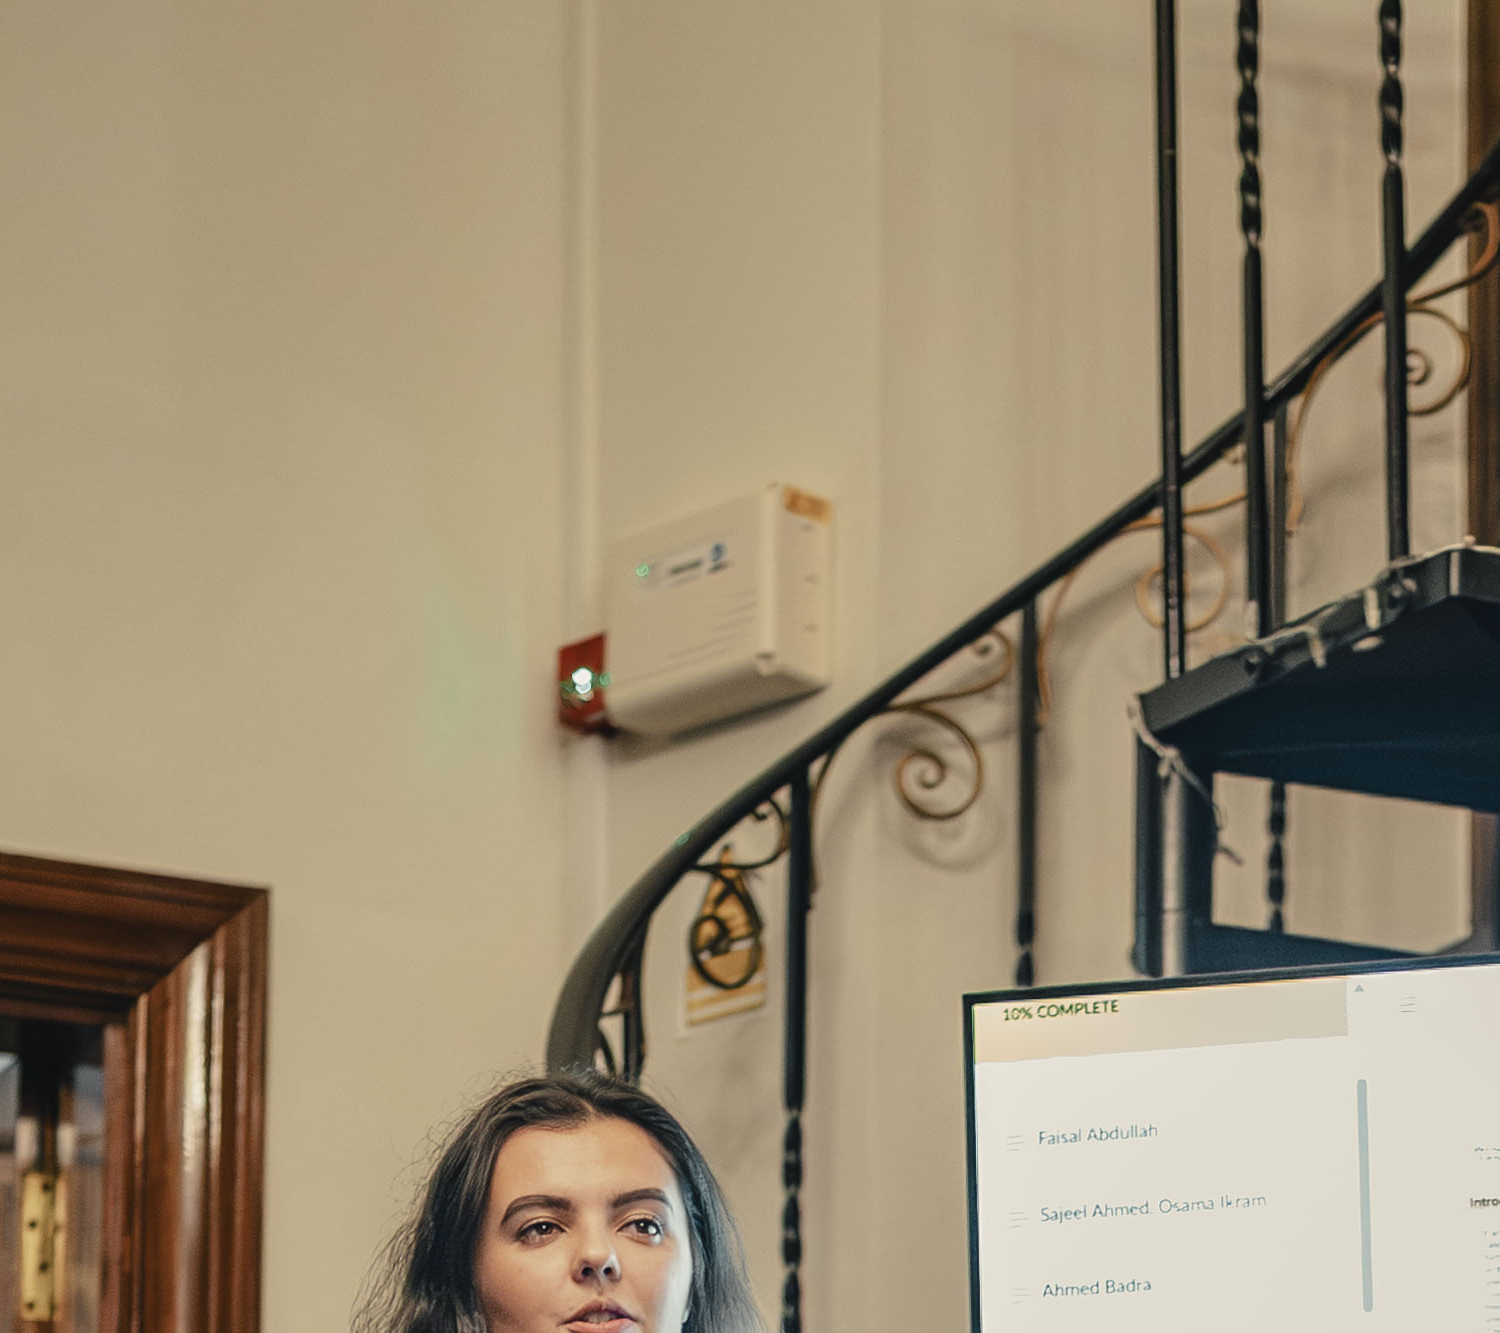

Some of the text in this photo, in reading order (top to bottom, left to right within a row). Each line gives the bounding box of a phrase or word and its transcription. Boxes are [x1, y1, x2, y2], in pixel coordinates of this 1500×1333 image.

[1003, 1000, 1119, 1021] 10% COMPLETE
[1038, 1123, 1158, 1147] Faisal Abdullah
[1040, 1205, 1087, 1223] Sajeel
[1158, 1198, 1214, 1213] Osama
[1042, 1278, 1152, 1298] Ahmed Badra
